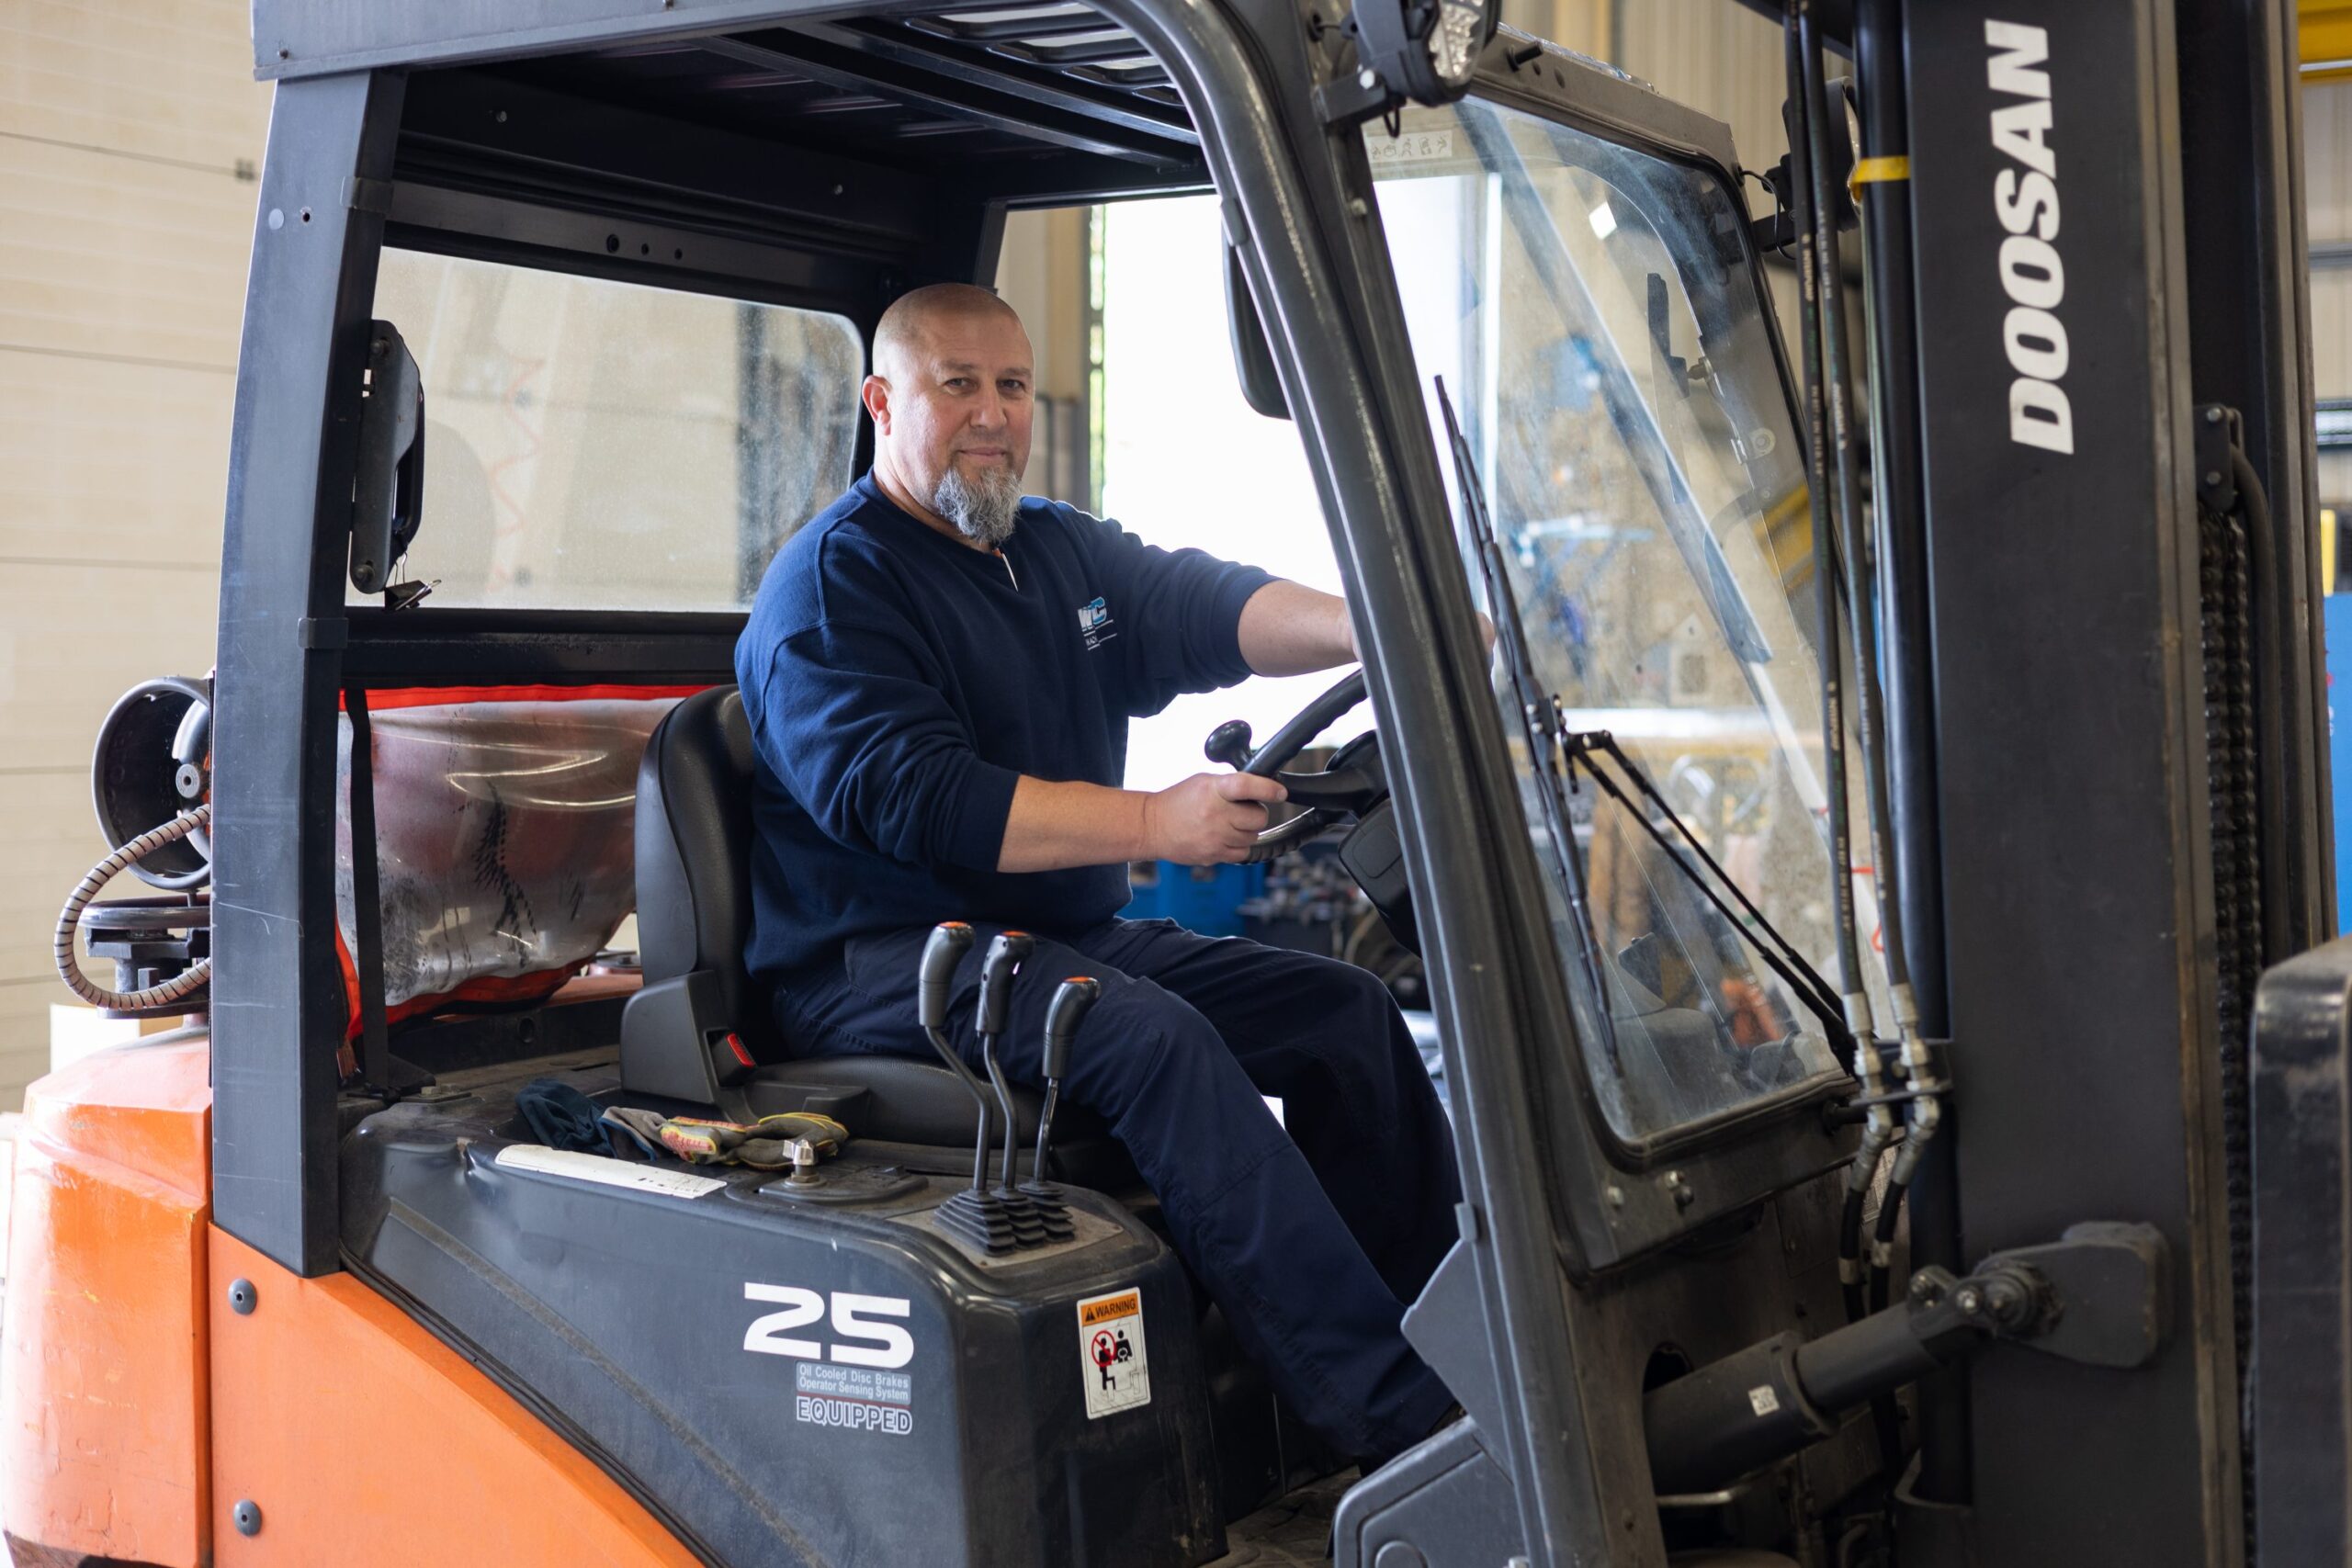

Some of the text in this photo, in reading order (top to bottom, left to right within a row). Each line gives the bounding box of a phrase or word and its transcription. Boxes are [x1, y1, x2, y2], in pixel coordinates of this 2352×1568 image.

[1984, 18, 2074, 455] DOOSAN
[1095, 1298, 1136, 1318] WARNING
[743, 1281, 914, 1369] 25
[799, 1363, 909, 1388] Oil Cooled Disc Brakes
[799, 1376, 909, 1401] Operator Sensing System
[796, 1395, 912, 1435] EQUIPPED
